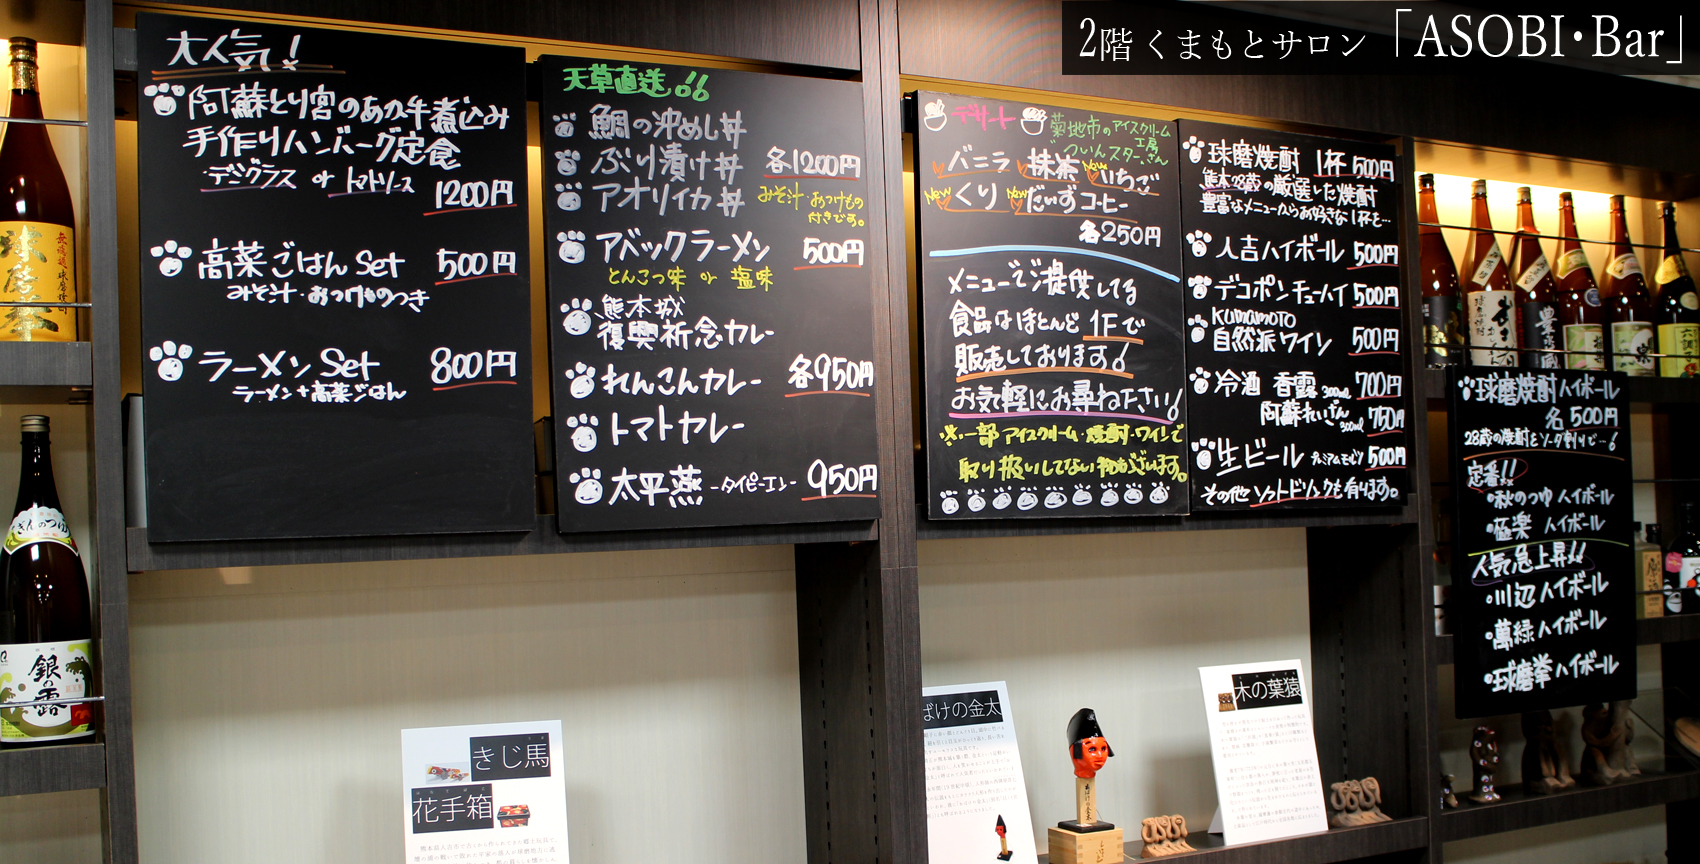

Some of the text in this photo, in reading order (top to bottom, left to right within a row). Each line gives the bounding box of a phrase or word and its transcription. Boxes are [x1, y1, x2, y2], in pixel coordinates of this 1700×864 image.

[166, 28, 302, 72] 大人気!
[188, 81, 510, 134] 阿蘇とり宮のあか牛煮込み
[1050, 111, 1172, 141] 菊地市のアイスクリーム
[183, 125, 462, 171] 手作りハンバーグ定食
[1134, 136, 1159, 155] 工房
[1207, 138, 1395, 183] 球磨焼酎 1杯 500円
[311, 170, 335, 188] or
[590, 142, 861, 186] ぶり漬け丼 各1200円
[947, 143, 1011, 174] バニラ
[1027, 146, 1081, 182] 抹茶
[1100, 167, 1161, 196] いちご
[434, 180, 514, 209] 1200円
[592, 176, 746, 218] アオリイカ丼
[955, 181, 998, 211] くり
[1199, 166, 1379, 209] 熊本28蔵の厳選した焼酎
[595, 227, 865, 267] アベックラーメン 500円
[1078, 219, 1162, 248] 各250円
[1215, 232, 1399, 267] 人吉ハイボール 500円
[198, 238, 517, 280] 高菜ごはん Set 500円
[607, 264, 775, 292] とんこつ味 or 塩味
[1214, 273, 1400, 308] デコポンチューハイ 500円
[226, 282, 430, 313] みそ汁・おつけものつき
[594, 293, 686, 321] 熊本城
[596, 315, 776, 351] 復興祈念カレー
[949, 299, 1146, 338] 食品はほとんど 1Fで
[1213, 325, 1399, 357] 自然派ワイン 500円
[198, 347, 517, 384] ラーメン Set 800円
[600, 353, 874, 397] れんこんカレー 各950円
[954, 341, 1131, 378] 販売しております!
[950, 379, 1184, 422] お気軽にお尋ね下さい!
[1213, 368, 1262, 398] 冷酒
[1272, 371, 1319, 399] 香露
[1354, 370, 1402, 399] 700円
[611, 404, 746, 446] トマトカレー
[1260, 398, 1350, 428] 阿蘇れいざん
[1367, 404, 1406, 432] 750円
[1569, 405, 1620, 428] 500円
[1216, 437, 1305, 477] 生ビール
[1367, 444, 1407, 469] 500円
[608, 463, 704, 509] 太平燕
[807, 458, 878, 499] 950円
[1492, 510, 1607, 542] 極楽 ハイボール
[27, 653, 68, 717] 銀の露
[1234, 676, 1304, 703] 木の葉猿
[472, 742, 550, 771] きじ馬
[411, 793, 494, 824] 花手箱
